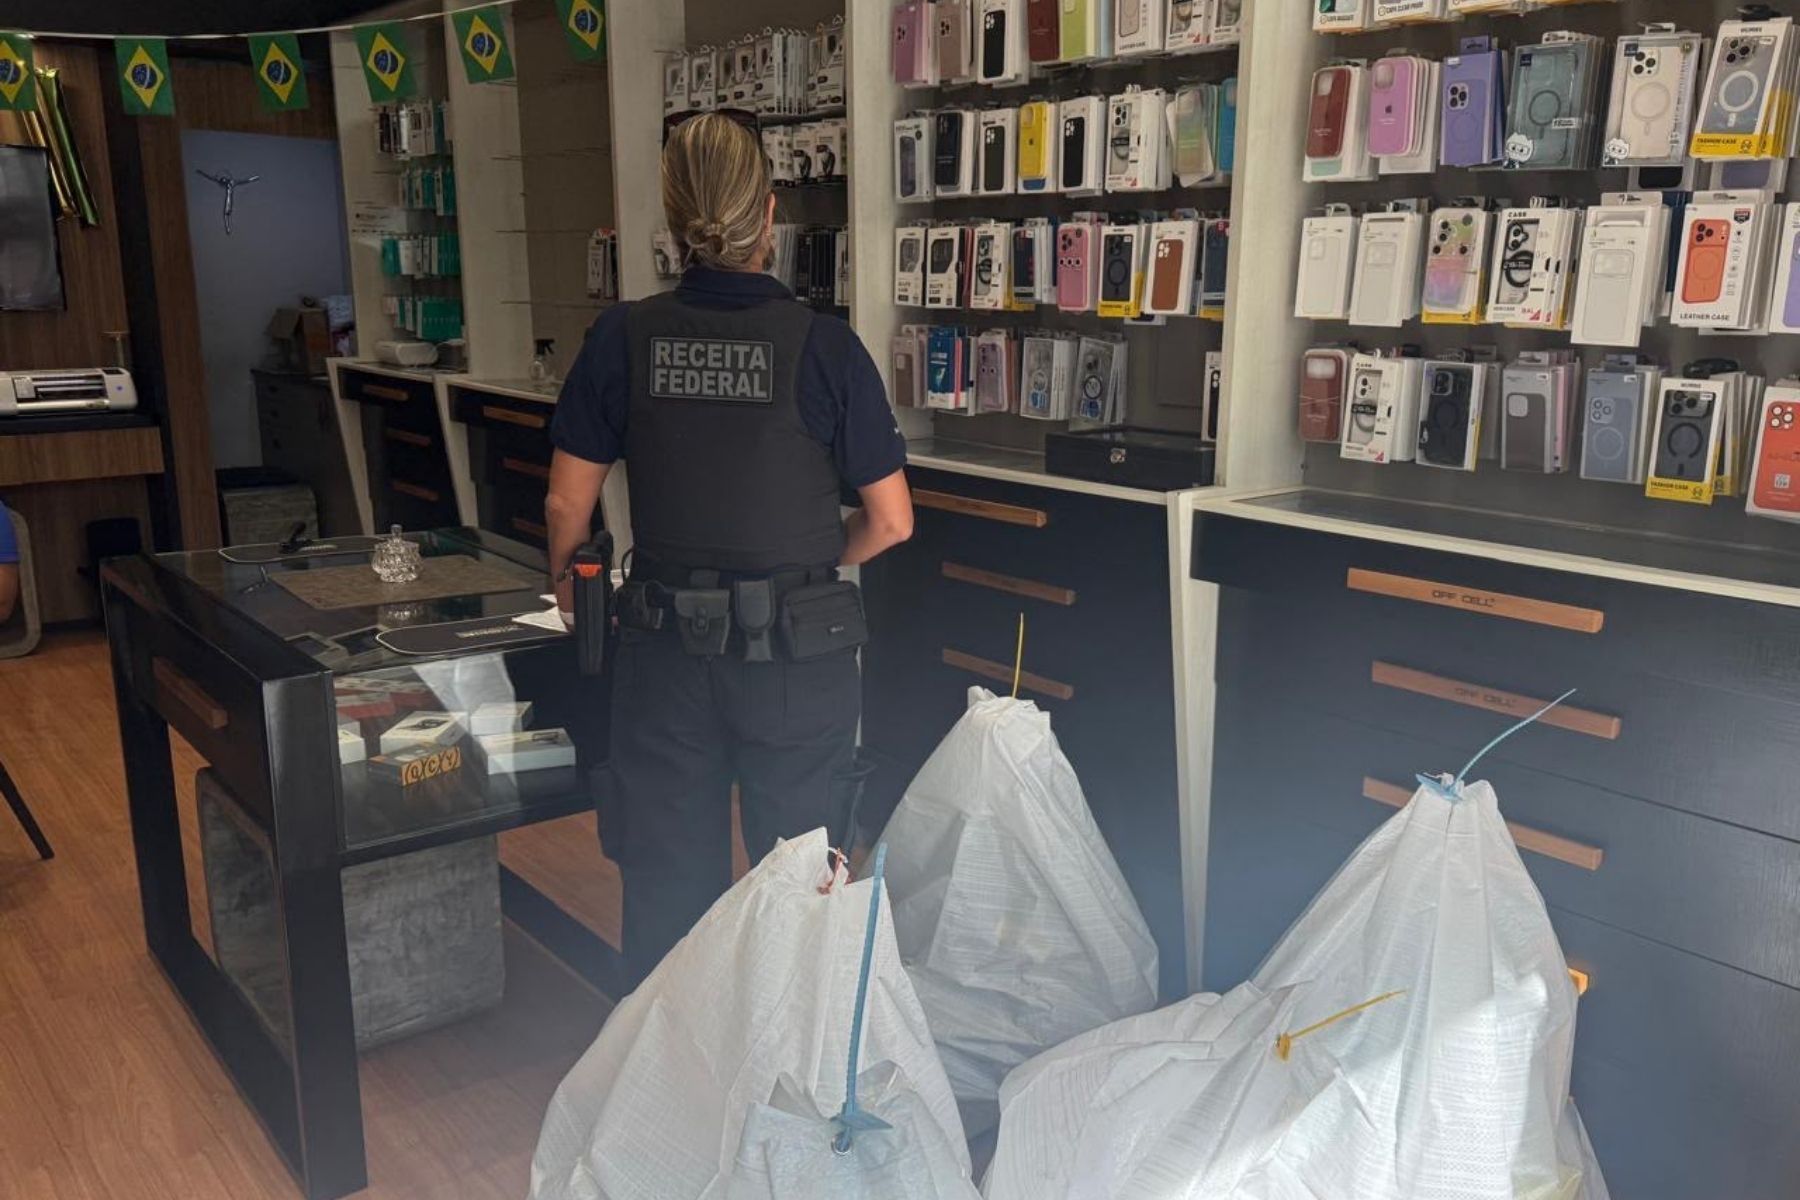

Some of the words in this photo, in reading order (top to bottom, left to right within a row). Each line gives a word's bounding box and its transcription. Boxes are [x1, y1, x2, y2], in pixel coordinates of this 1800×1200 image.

[1711, 313, 1730, 321] CASE
[655, 341, 767, 370] RECEITA
[655, 368, 767, 398] FEDERAL
[1432, 590, 1457, 599] OFF
